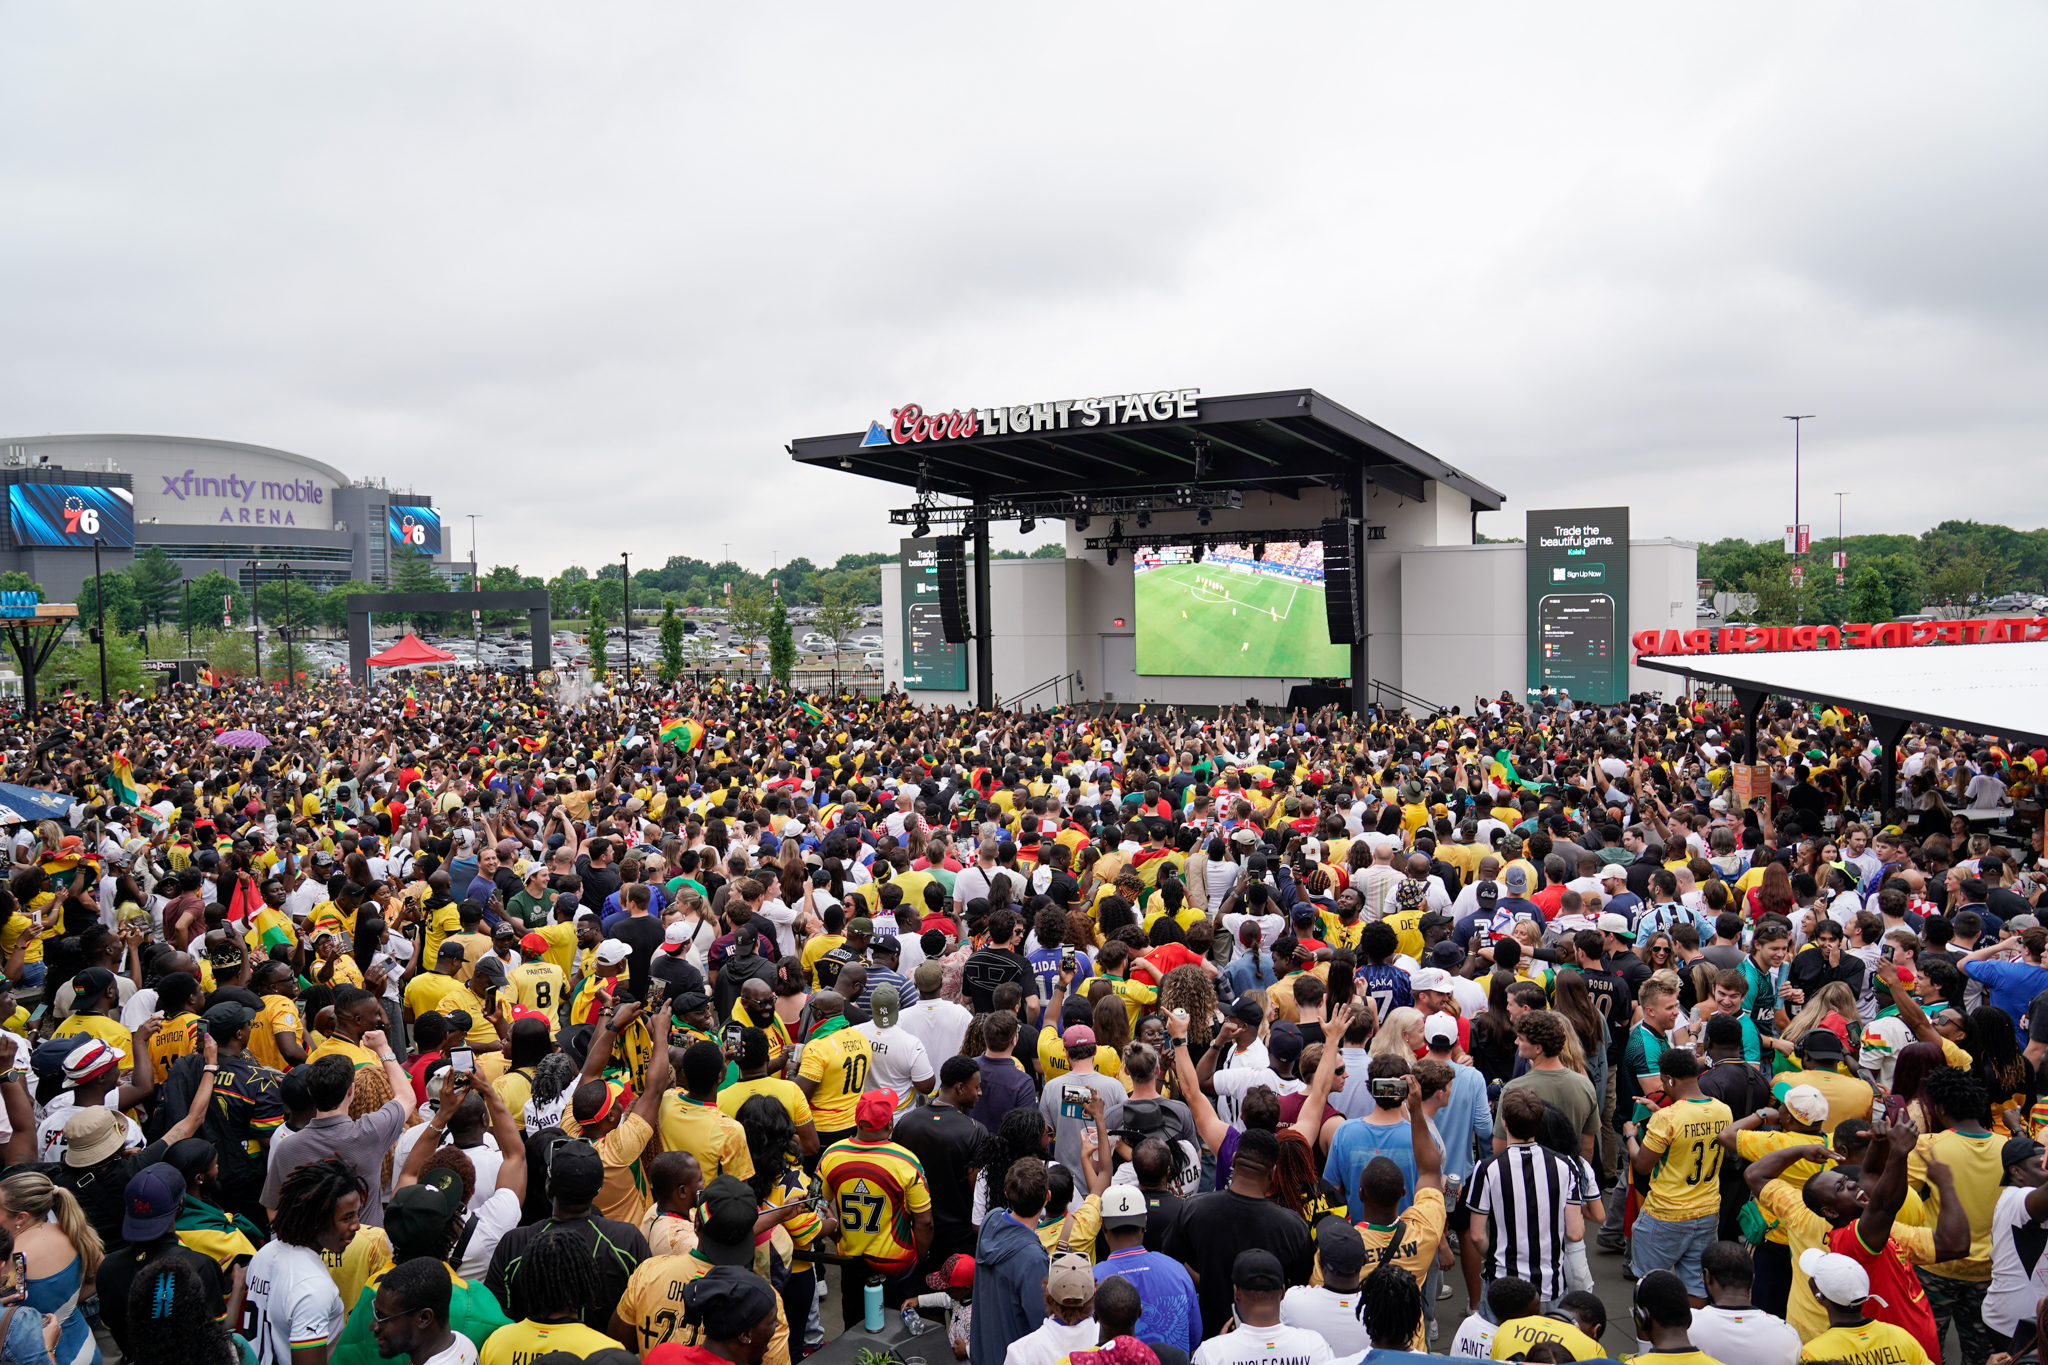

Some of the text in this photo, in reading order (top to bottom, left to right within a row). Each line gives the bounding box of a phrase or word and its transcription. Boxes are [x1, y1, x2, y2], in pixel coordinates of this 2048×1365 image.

[890, 387, 1200, 444] Coors LIGHT STAGE
[162, 469, 323, 504] xfinity mobile
[64, 507, 100, 535] 76
[220, 507, 295, 525] ARENA
[402, 523, 425, 546] 76
[1554, 525, 1599, 536] Trade the
[1540, 536, 1614, 548] beautiful game.
[917, 550, 934, 558] Trade
[908, 558, 934, 567] beautiful
[1567, 570, 1580, 578] Sign
[1400, 918, 1414, 930] DE
[526, 968, 553, 976] PAINTSIL
[1032, 961, 1057, 973] ZIDA
[1370, 978, 1392, 989] SAKA
[1588, 979, 1613, 992] POGBA
[536, 981, 551, 1008] 8
[1371, 990, 1393, 1024] 7
[842, 1040, 863, 1052] PERCY
[870, 1040, 888, 1054] OFI
[842, 1054, 866, 1094] 10
[527, 1113, 559, 1128] AKSUA
[1684, 1122, 1711, 1138] FRESH
[840, 1193, 886, 1234] 57
[1843, 1346, 1906, 1365] MAXWELL
